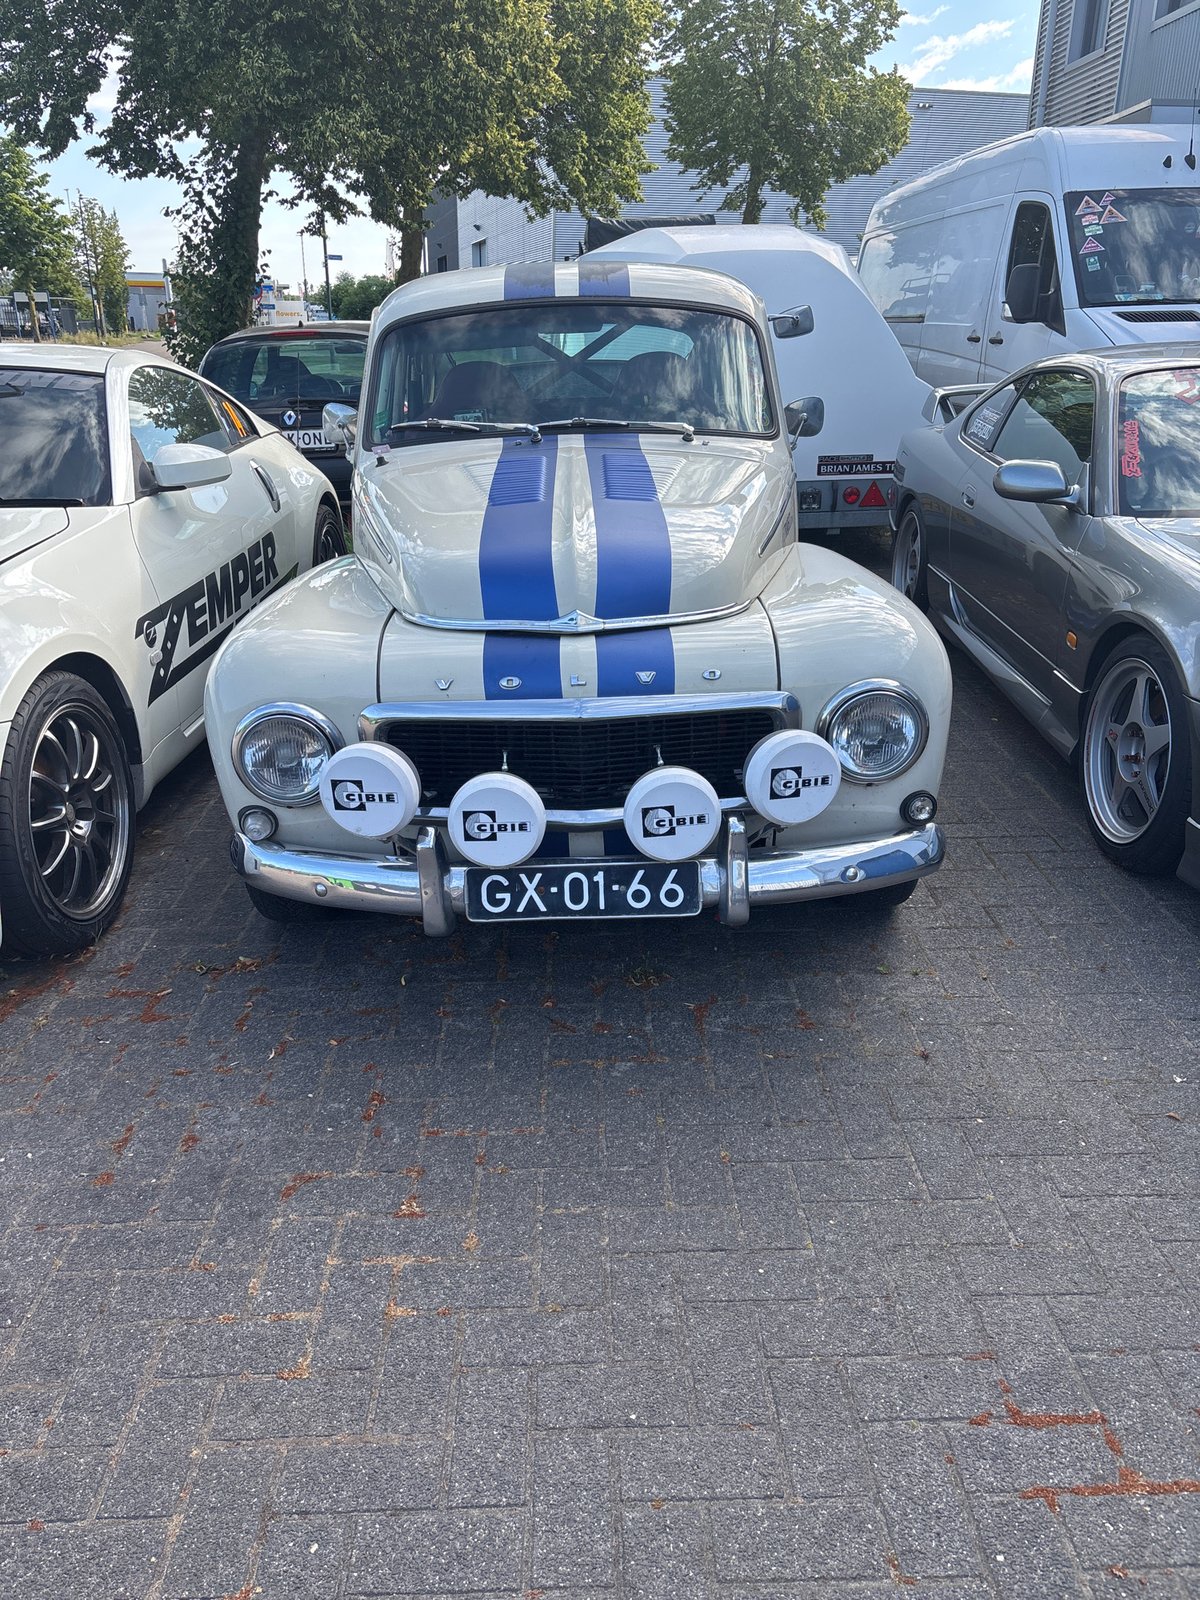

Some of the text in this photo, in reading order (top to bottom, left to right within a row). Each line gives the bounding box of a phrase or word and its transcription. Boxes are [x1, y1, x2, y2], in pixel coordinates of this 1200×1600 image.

[820, 464, 850, 473] BRIAN
[850, 463, 883, 474] JAMES
[434, 669, 721, 690] VOLVO
